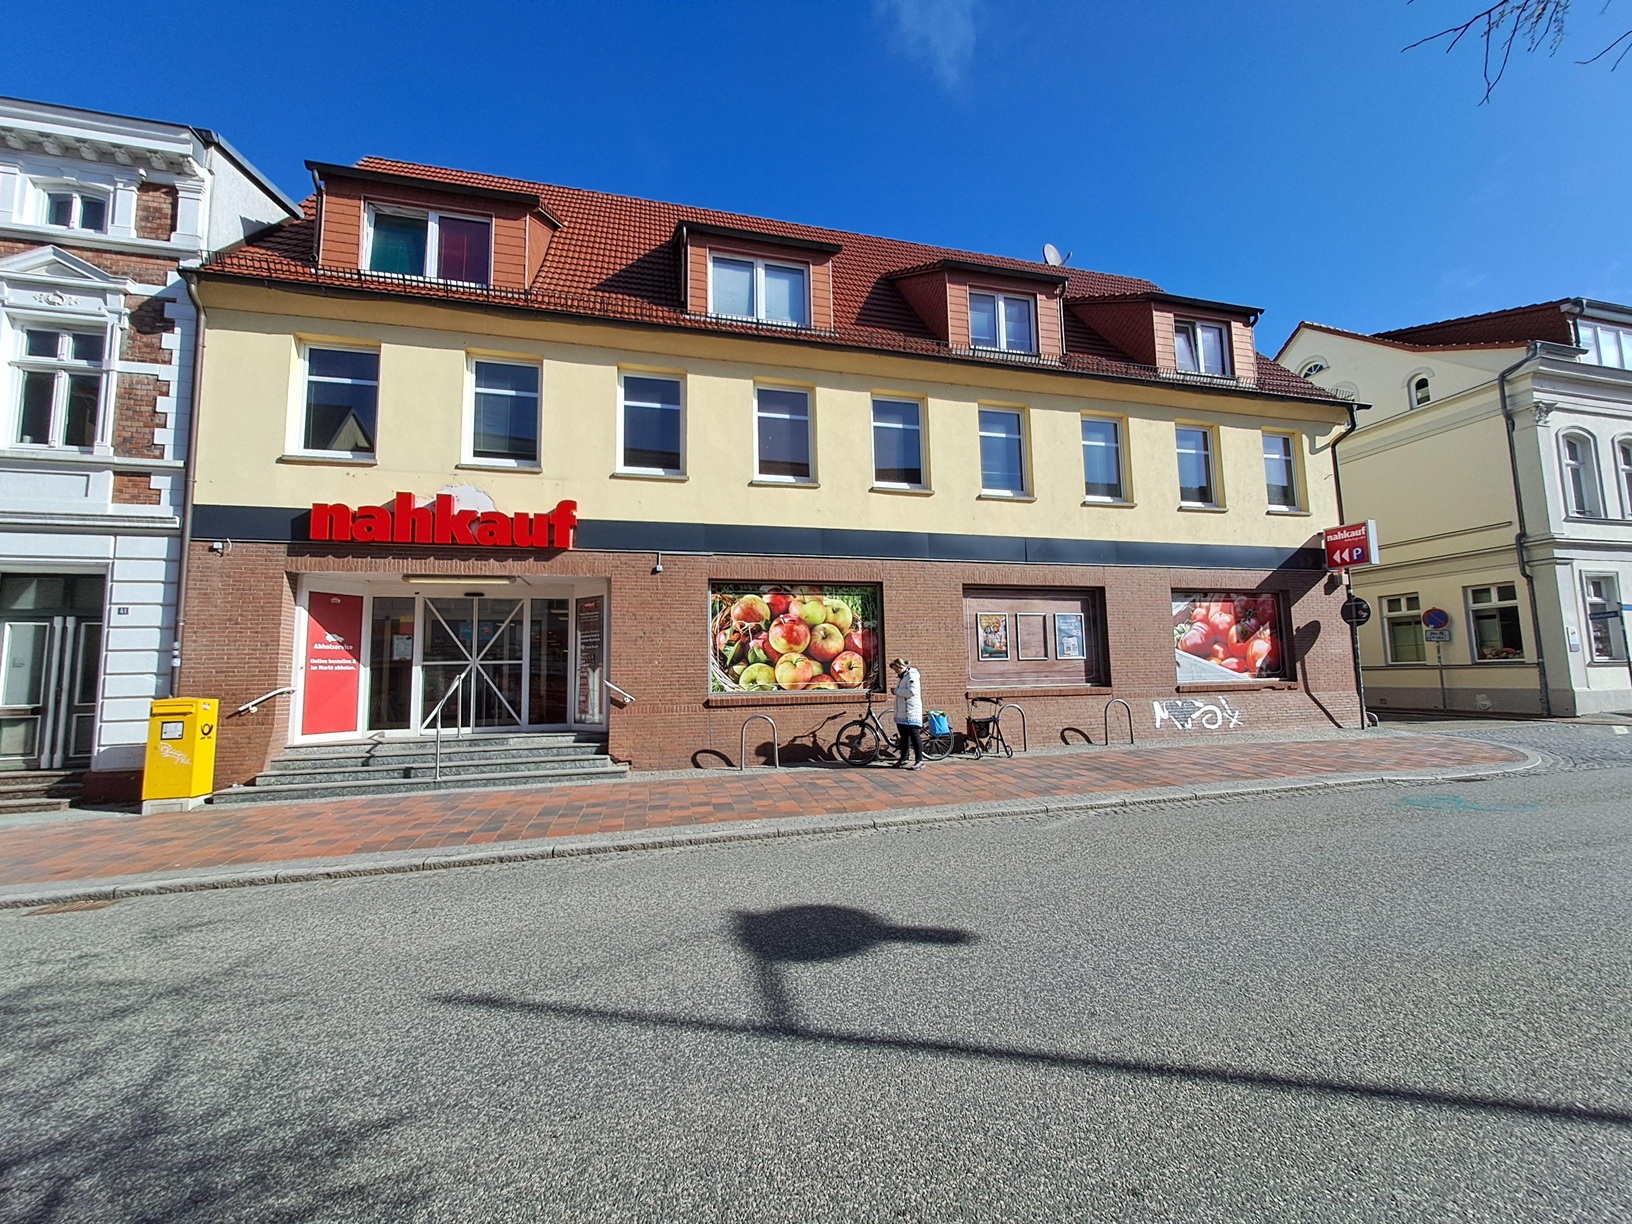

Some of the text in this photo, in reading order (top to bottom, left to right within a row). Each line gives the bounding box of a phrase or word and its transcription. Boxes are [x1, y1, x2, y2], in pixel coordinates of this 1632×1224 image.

[310, 491, 578, 548] nahkauf
[1326, 526, 1366, 541] nahkauf
[1353, 547, 1362, 560] P
